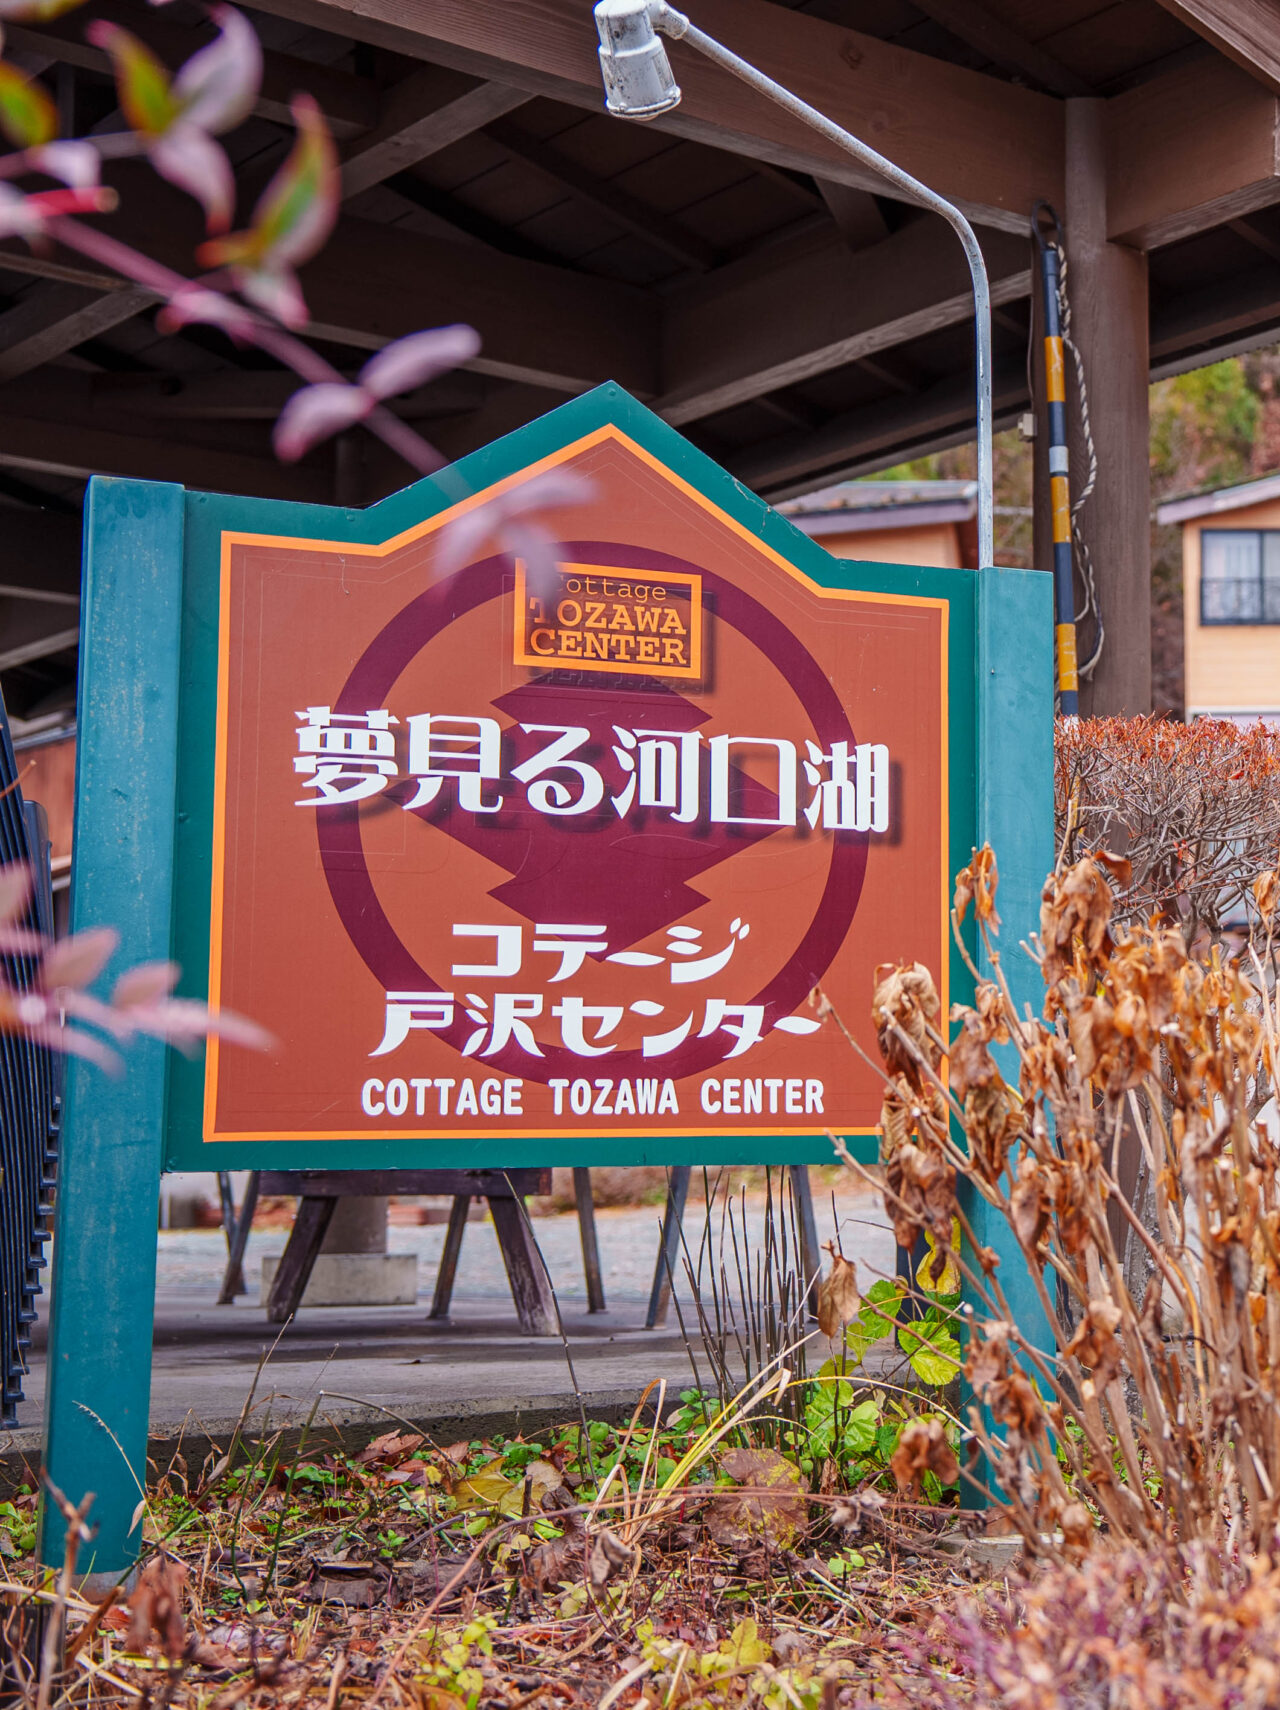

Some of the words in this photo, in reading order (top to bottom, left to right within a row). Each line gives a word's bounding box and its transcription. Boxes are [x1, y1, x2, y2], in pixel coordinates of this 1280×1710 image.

[530, 628, 687, 664] CENTER
[293, 706, 890, 833] 夢見る河口湖
[451, 917, 750, 985] コテージ
[367, 991, 823, 1059] 戸沢センター
[361, 1078, 524, 1116] COTTAGE
[548, 1078, 680, 1116] TOZAWA
[700, 1078, 825, 1115] CENTER
